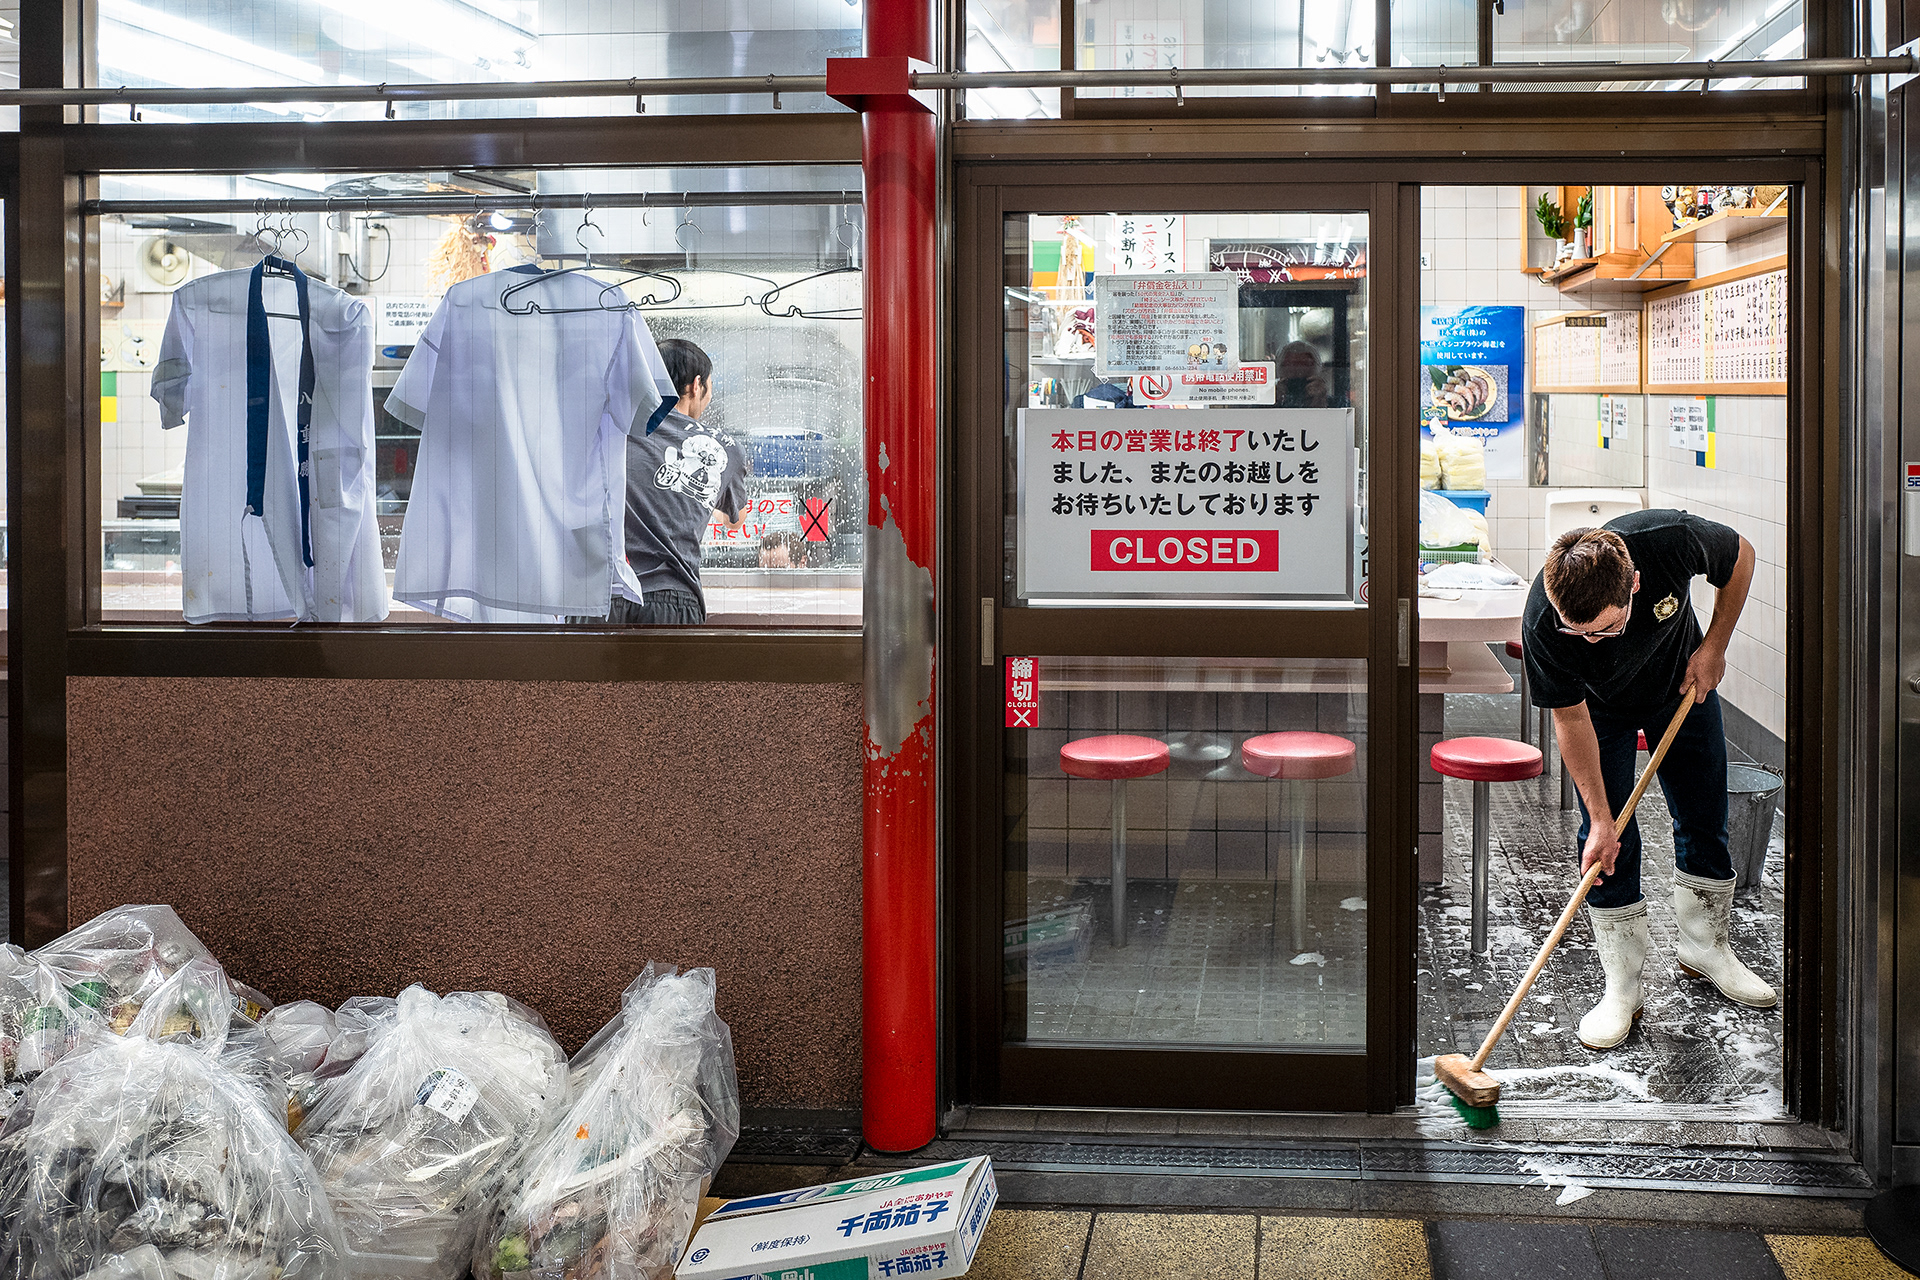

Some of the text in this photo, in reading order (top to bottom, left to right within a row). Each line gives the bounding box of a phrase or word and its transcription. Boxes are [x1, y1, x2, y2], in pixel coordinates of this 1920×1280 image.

[1121, 220, 1137, 270] お断り
[1051, 429, 1320, 452] 本日の営業は終了いたし
[1052, 461, 1319, 484] ました、またのお越しを
[1051, 493, 1320, 516] お待ちいたしております
[1109, 537, 1260, 564] CLOSED
[1012, 658, 1033, 701] 締切
[844, 1176, 905, 1193] 岡山
[836, 1200, 949, 1238] 千両茄子
[879, 1250, 949, 1277] 千両茄子
